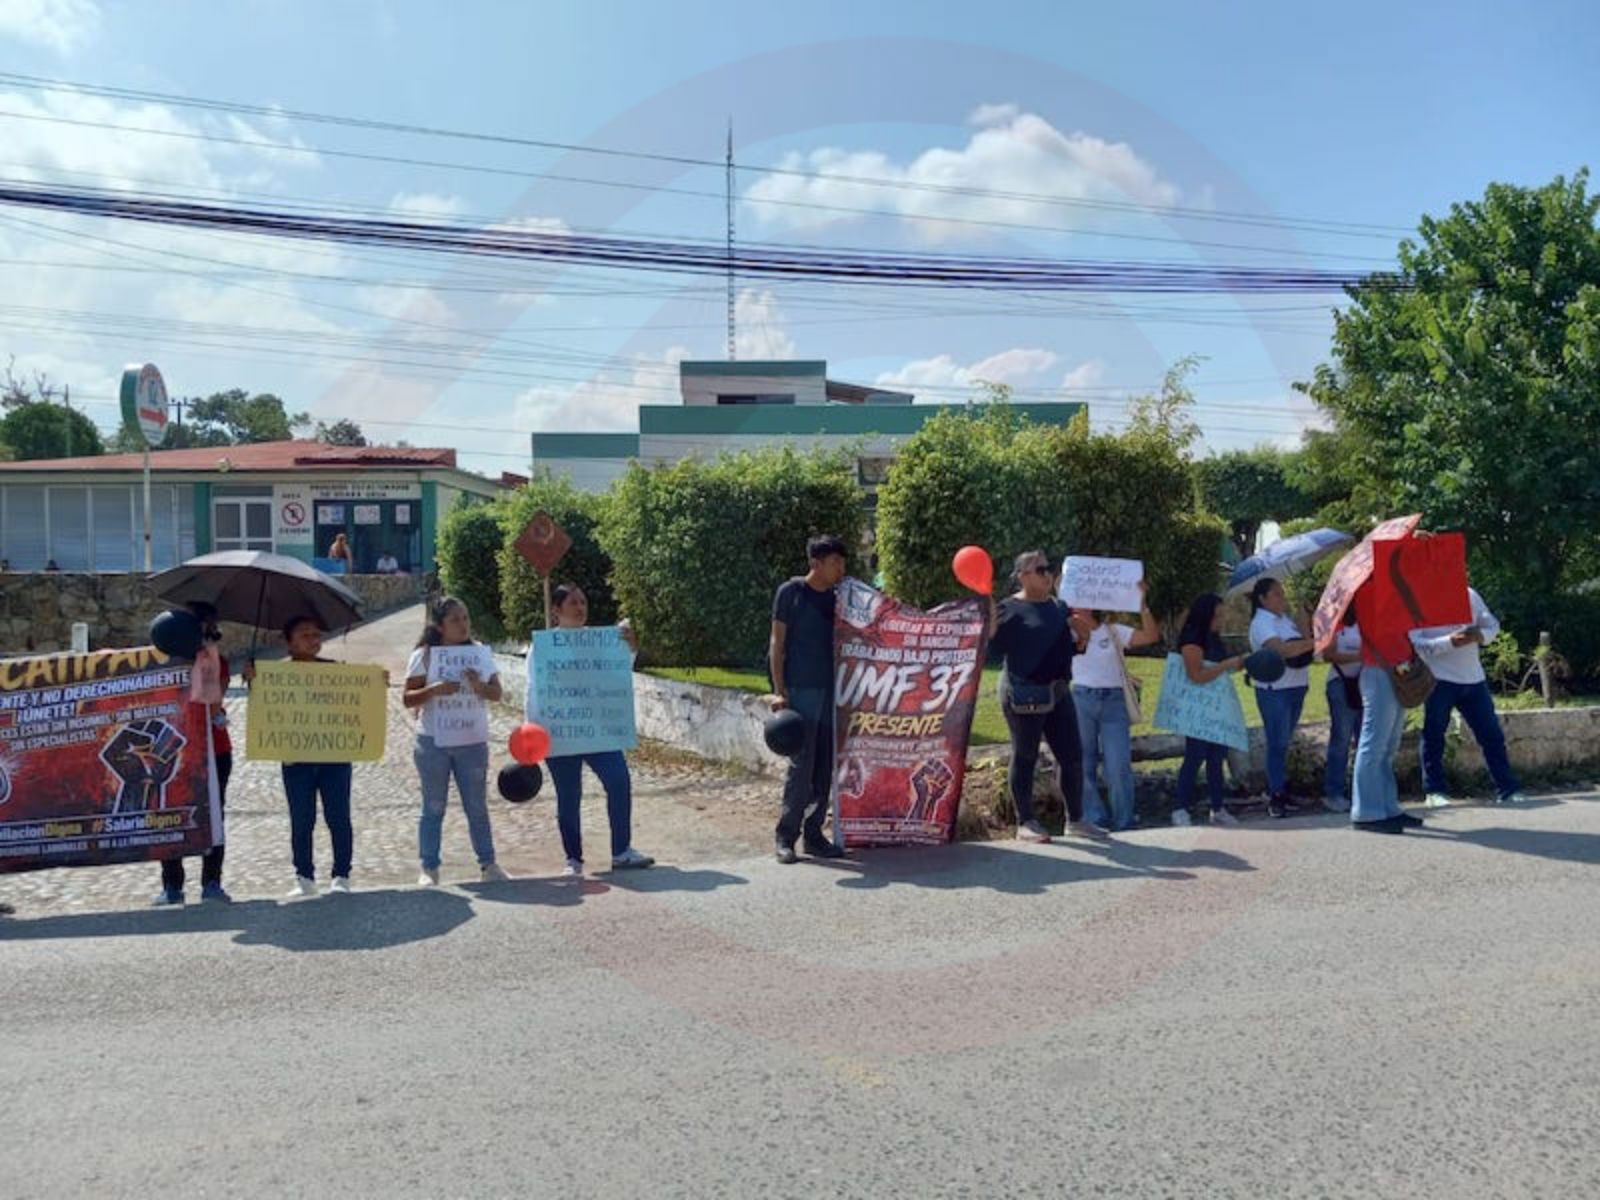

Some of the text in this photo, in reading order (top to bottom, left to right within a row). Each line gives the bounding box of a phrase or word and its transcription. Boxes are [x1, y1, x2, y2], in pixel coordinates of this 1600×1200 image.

[43, 687, 61, 703] NO
[835, 662, 976, 713] UMF 37
[848, 712, 945, 735] PRESENTE
